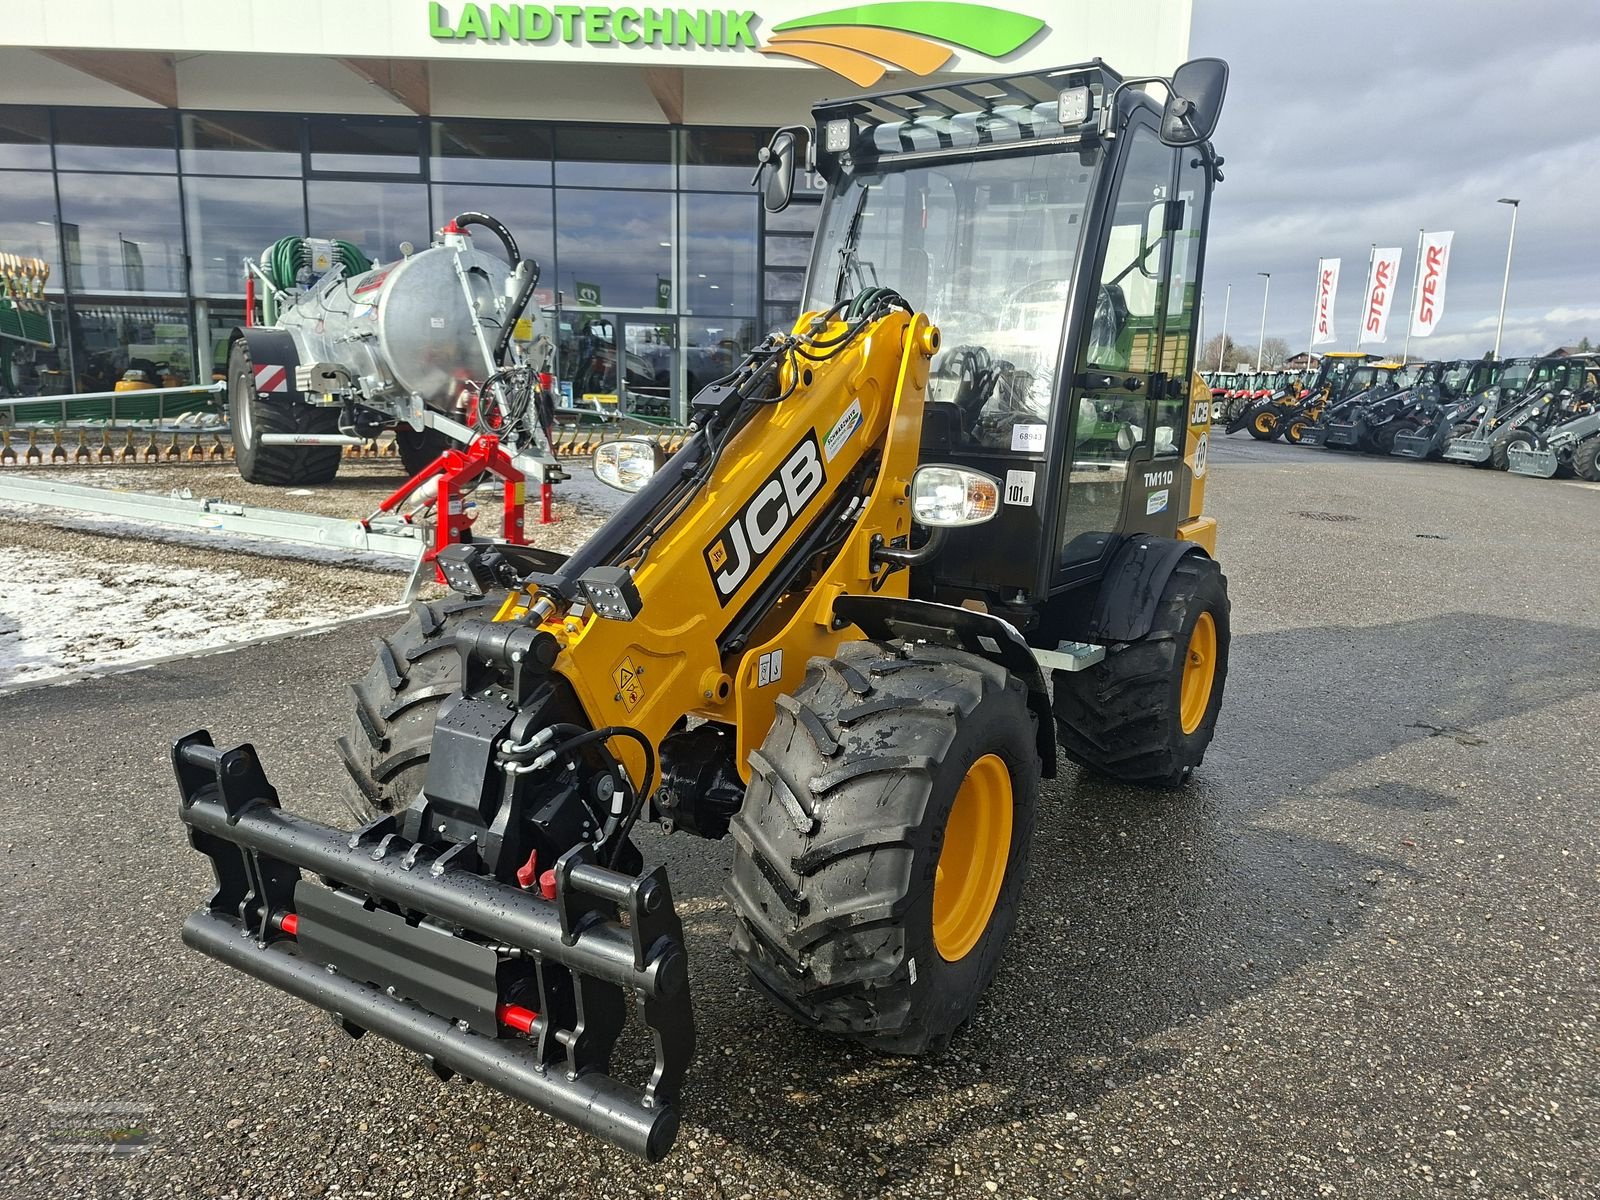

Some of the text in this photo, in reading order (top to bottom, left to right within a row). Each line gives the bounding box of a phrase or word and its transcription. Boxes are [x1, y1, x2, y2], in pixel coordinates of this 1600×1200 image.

[429, 2, 756, 47] LANDTECHNIK
[1318, 269, 1333, 335] STEYR
[1366, 260, 1391, 334] STEYR
[1419, 245, 1443, 325] STEYR
[1191, 402, 1209, 424] JCB
[1009, 485, 1024, 502] 101
[1143, 470, 1173, 488] TM110
[717, 439, 823, 595] JCB
